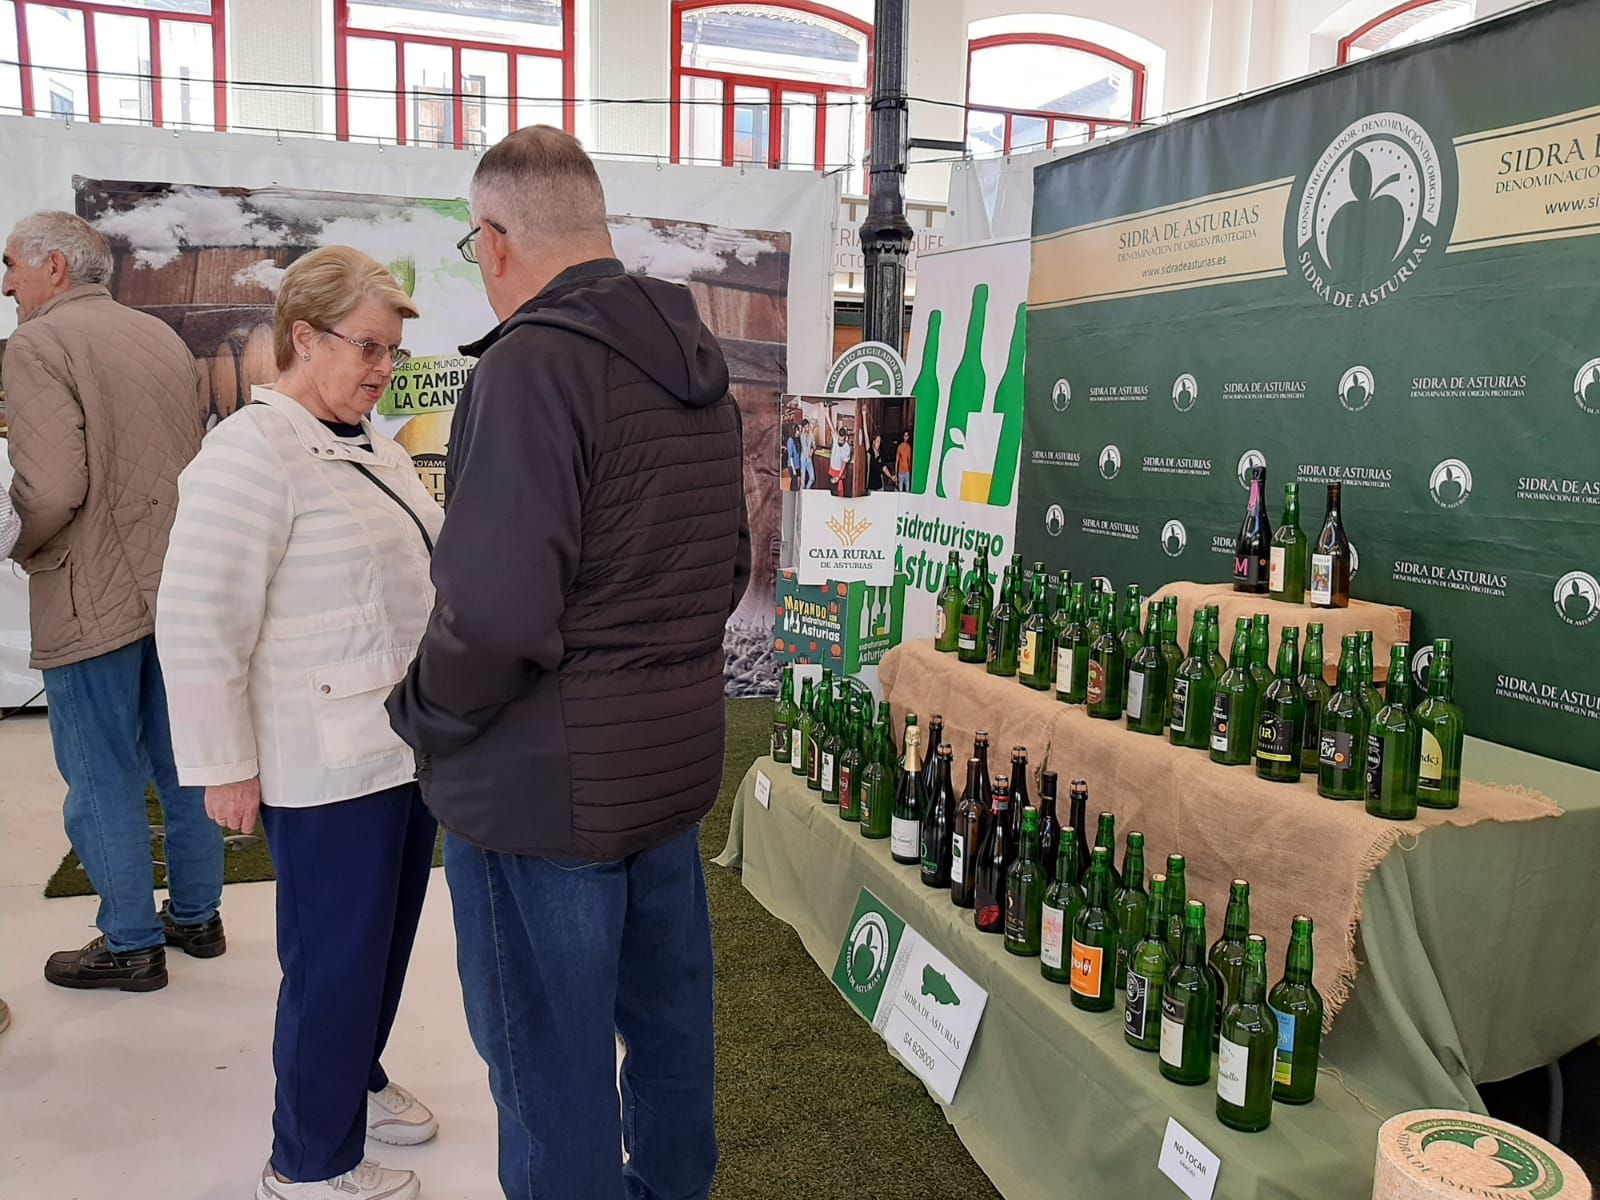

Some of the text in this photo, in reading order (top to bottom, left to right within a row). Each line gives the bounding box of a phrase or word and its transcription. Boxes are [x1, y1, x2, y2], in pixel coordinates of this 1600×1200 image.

[1498, 138, 1585, 176] SIDRA
[1120, 204, 1260, 249] SIDRA DE ASTURIAS
[1142, 255, 1227, 278] www.sidradeasturias.es
[1298, 233, 1432, 308] SIDRA DE ASTURIAS
[422, 361, 432, 370] AL
[390, 374, 408, 391] YO
[1118, 386, 1149, 395] ASTURIAS
[1223, 381, 1306, 392] SIDRA DE ASTURIAS
[1411, 375, 1527, 389] SIDRA DE ASTURIAS
[394, 392, 414, 409] LA
[1143, 456, 1211, 469] SIDRA DE ASTURIAS
[1298, 465, 1392, 480] SIDRA DE ASTURIAS
[1518, 477, 1558, 492] SIDRA
[1562, 480, 1579, 494] DE
[896, 511, 1004, 557] sidraturismo
[1110, 521, 1140, 534] ASTURIAS
[1212, 536, 1237, 547] SIDRA
[809, 548, 885, 561] CAJA RURAL
[820, 561, 873, 570] DE ASTURIAS
[1234, 556, 1248, 576] M
[1394, 561, 1508, 589] SIDRA DE ASTURIAS
[784, 595, 826, 619] MAYANDO
[801, 624, 840, 642] Asturias
[1497, 675, 1538, 695] SIDRA
[1541, 683, 1558, 699] DE
[903, 990, 961, 1050] SIDRA DE ASTURIAS
[912, 1041, 935, 1071] 629000
[1173, 1140, 1207, 1176] NO TOCAR
